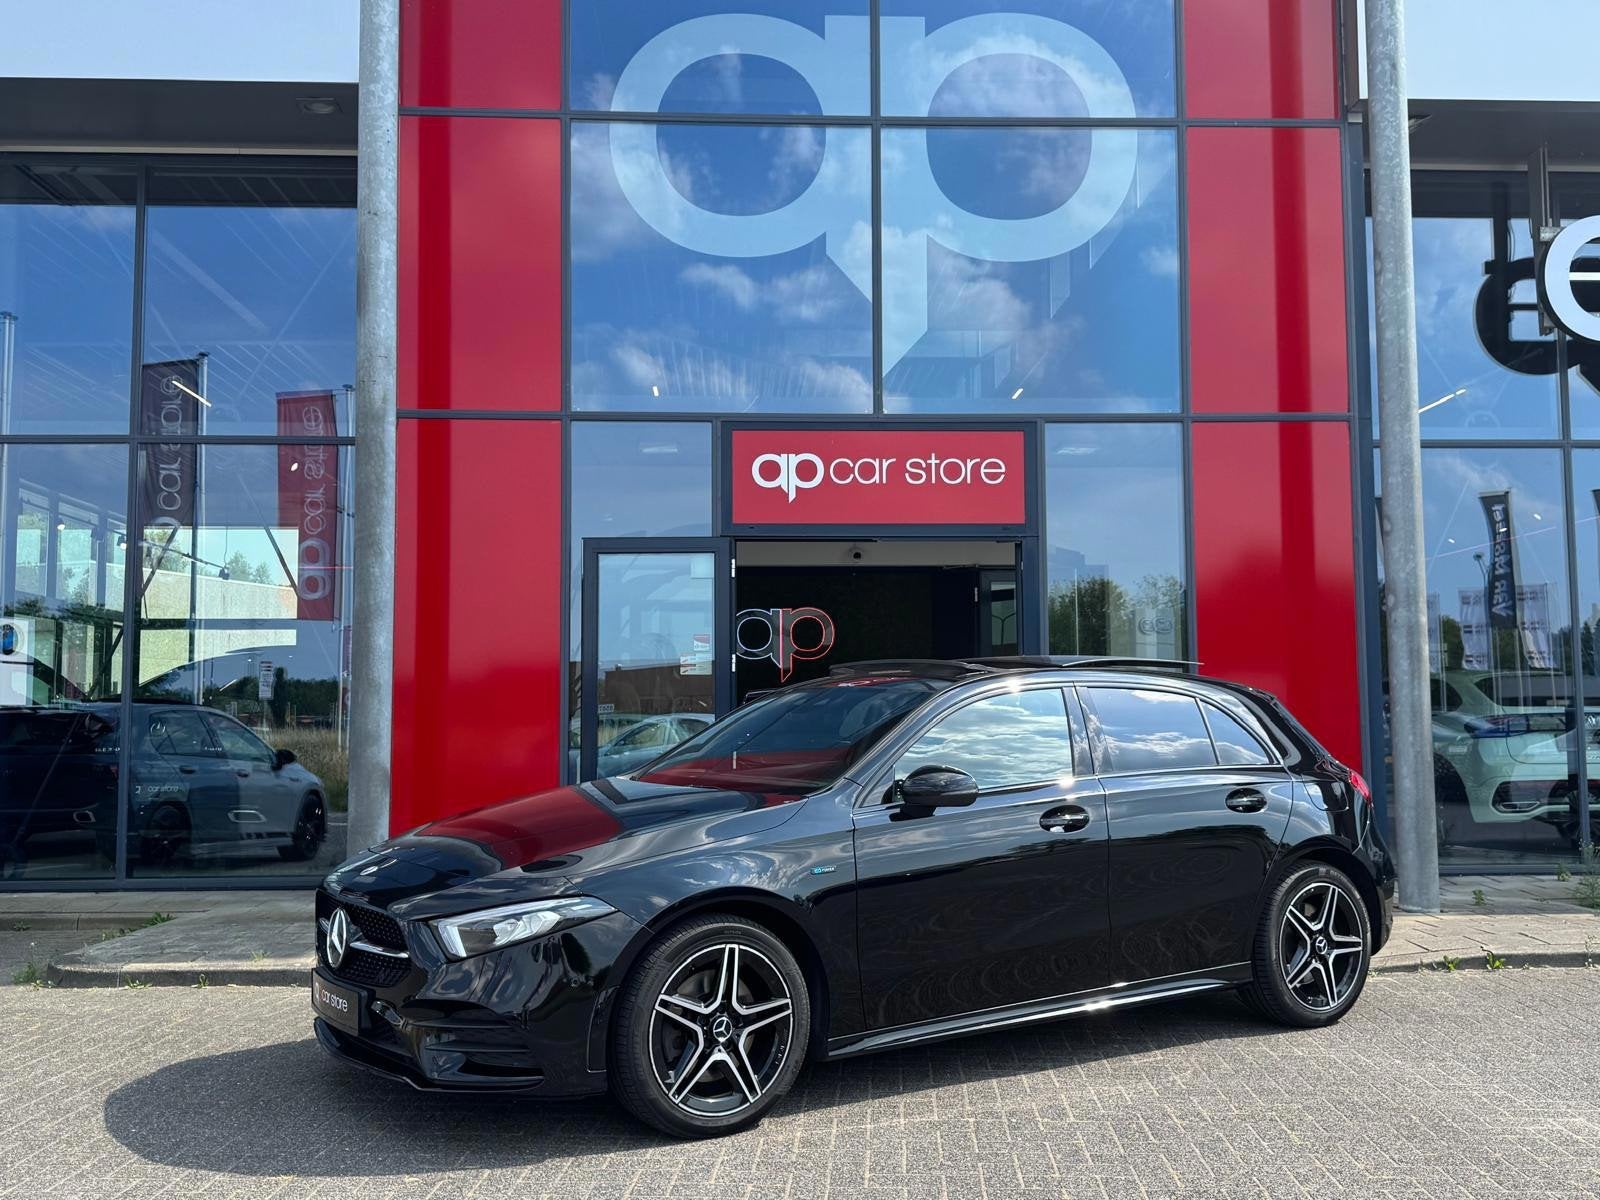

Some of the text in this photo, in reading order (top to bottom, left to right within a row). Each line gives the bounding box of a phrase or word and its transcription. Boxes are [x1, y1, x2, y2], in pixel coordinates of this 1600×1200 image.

[751, 452, 1007, 504] ap car store
[736, 606, 835, 683] ap
